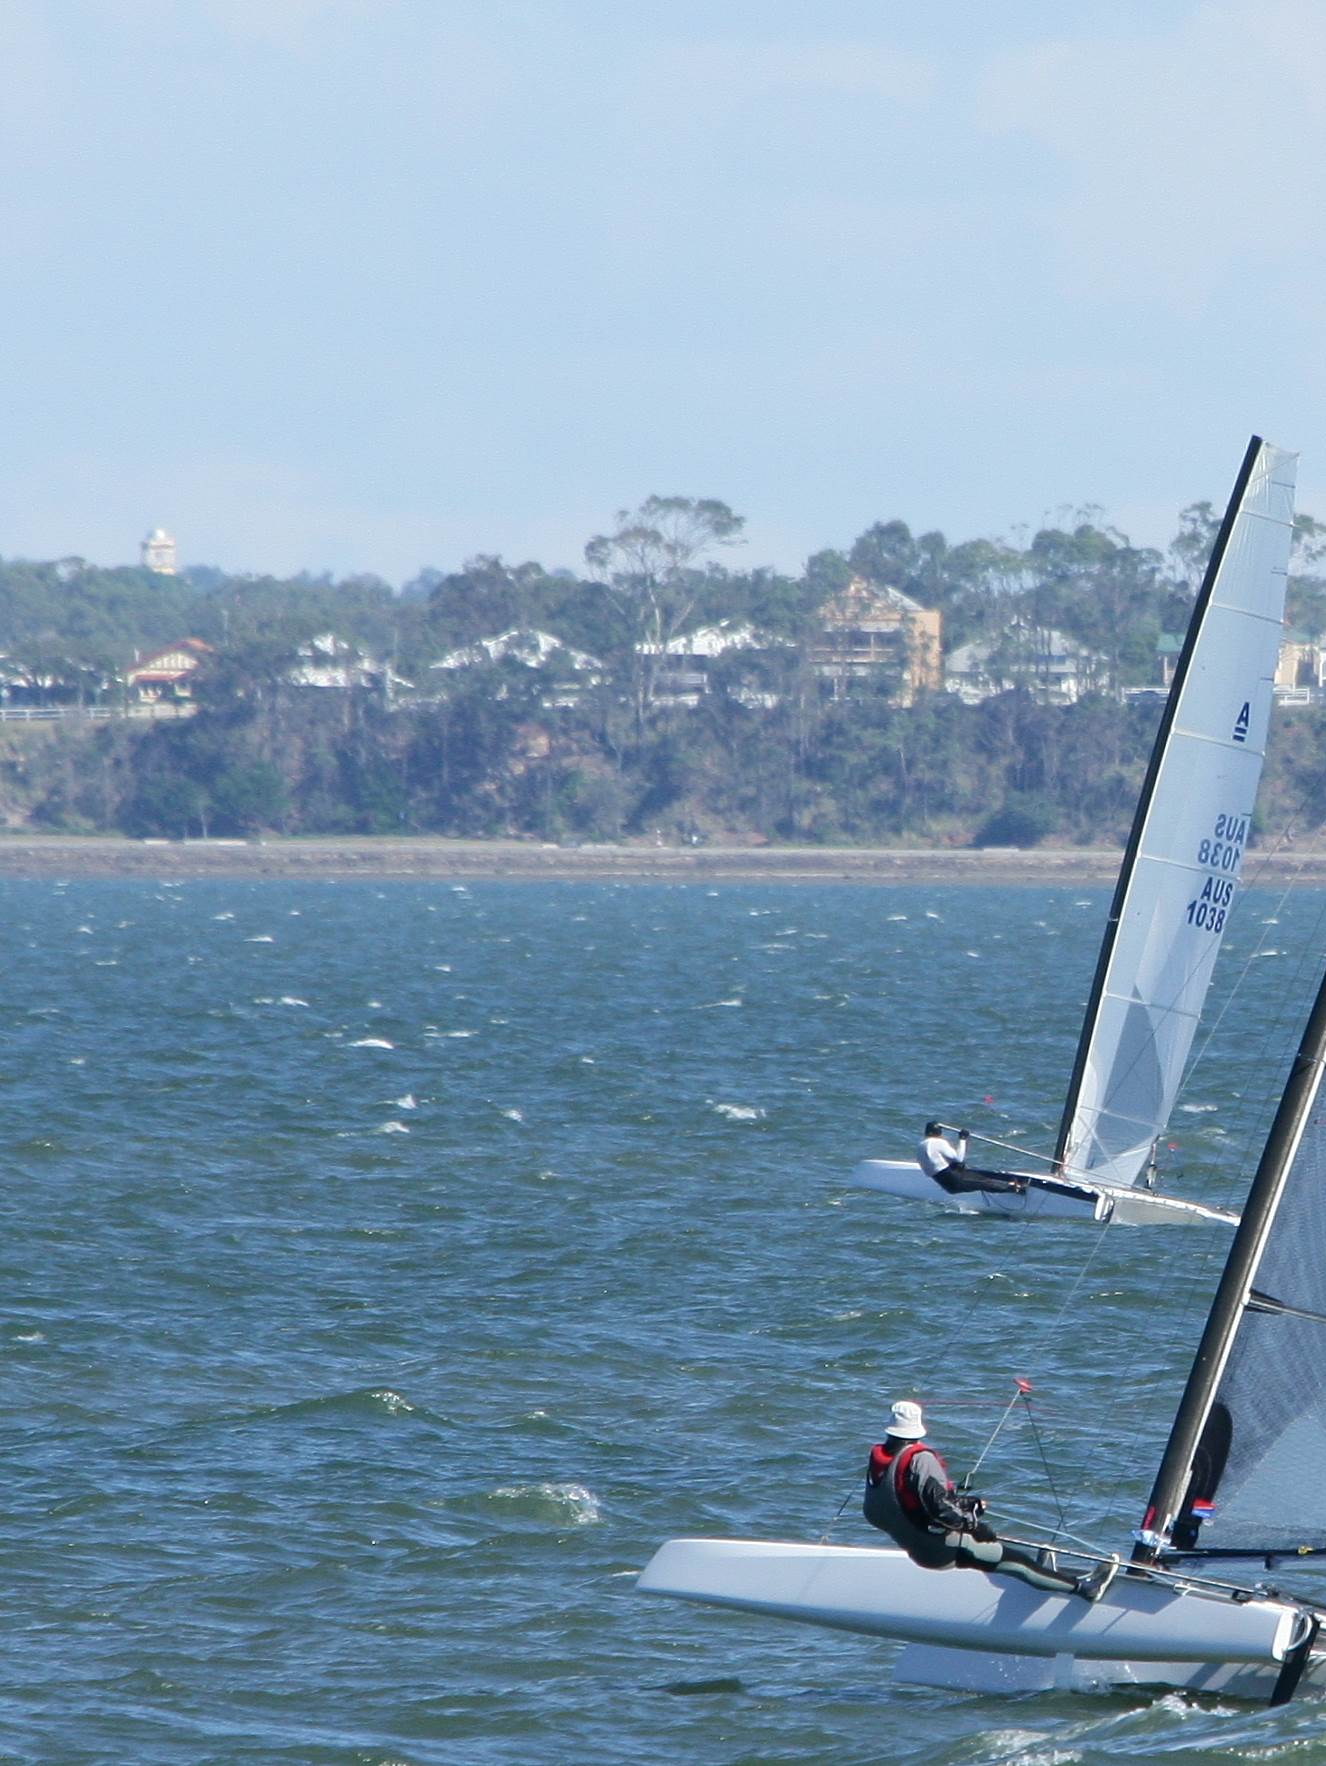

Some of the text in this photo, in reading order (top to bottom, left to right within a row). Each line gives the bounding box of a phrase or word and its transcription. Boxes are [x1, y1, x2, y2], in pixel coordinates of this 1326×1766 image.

[1236, 701, 1250, 728] A
[1200, 876, 1234, 908] AUS
[1186, 899, 1227, 934] 1038
